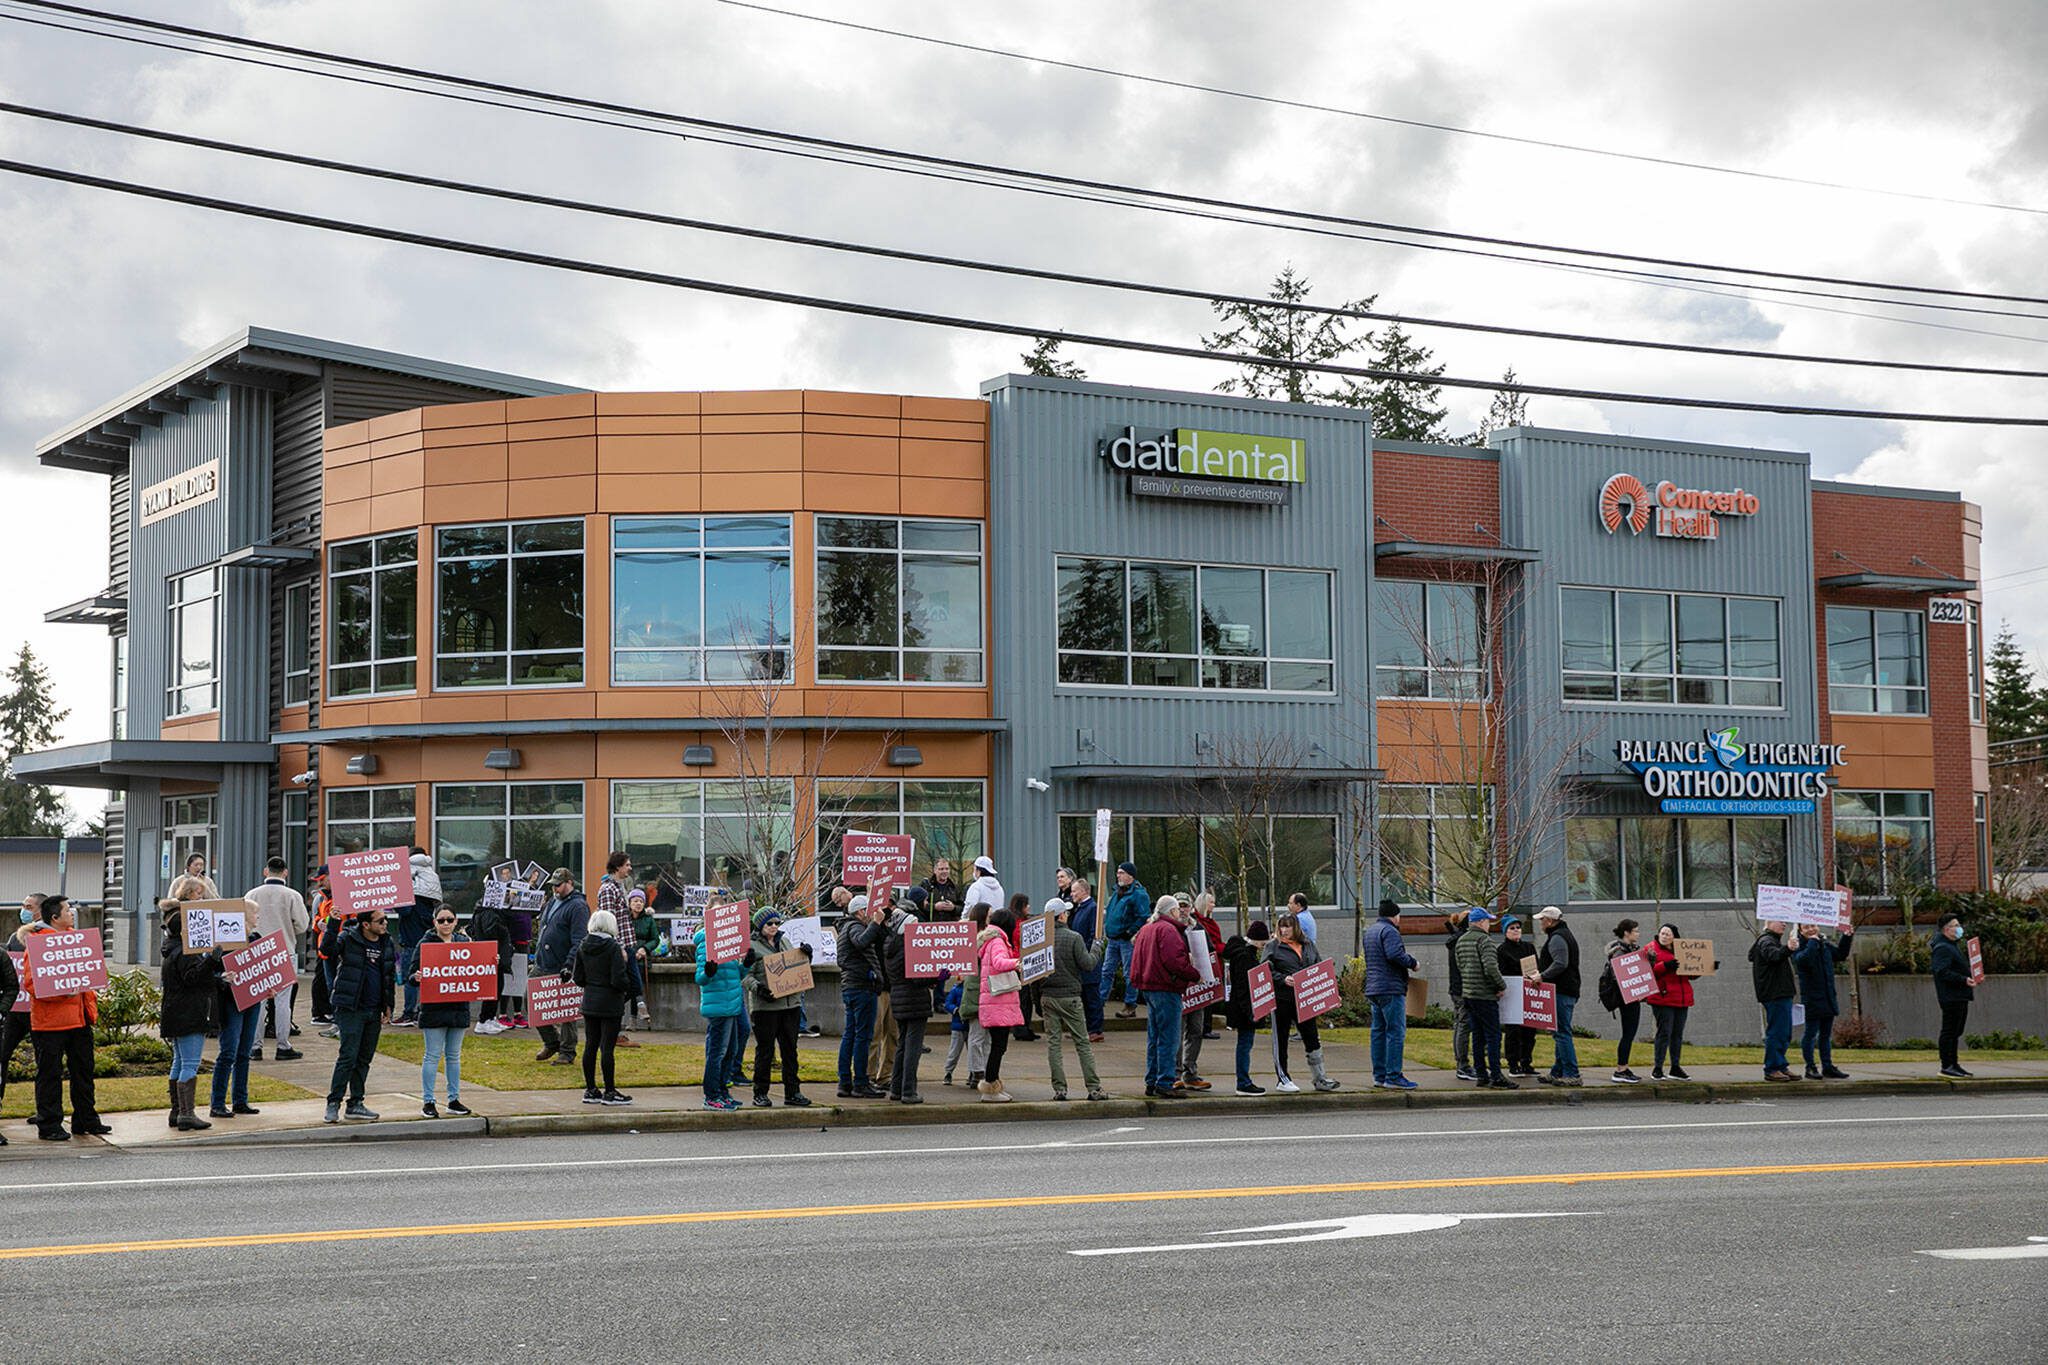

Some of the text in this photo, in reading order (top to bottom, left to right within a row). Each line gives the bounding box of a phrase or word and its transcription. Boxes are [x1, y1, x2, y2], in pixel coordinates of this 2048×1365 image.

[172, 470, 215, 505] BUILDING
[1139, 477, 1284, 504] family & preventive dentistry
[1656, 481, 1760, 515] Concerto
[1657, 507, 1719, 538] Health
[1932, 601, 1963, 621] 2322
[1619, 740, 1848, 766] BALANCE EPIGENETIC
[1644, 766, 1828, 798] ORTHODONTICS
[1720, 801, 1812, 812] ORTHOPEDICS-SLEEP
[866, 836, 887, 844] STOP
[343, 852, 395, 867] SAY NO TO
[340, 863, 401, 877] "PRETENDING
[352, 875, 392, 887] TO CARE
[349, 885, 398, 899] PROFITING
[352, 900, 370, 909] OFF
[371, 896, 398, 907] PAIN"
[189, 910, 205, 921] NO
[715, 904, 738, 918] DEPT OF
[713, 914, 741, 929] HEALTH IS
[717, 926, 739, 938] RUBBER
[916, 925, 968, 935] ACADIA IS
[46, 933, 85, 947] STOP
[713, 935, 743, 950] STAMPING
[912, 937, 972, 947] FOR PROFIT,
[42, 946, 93, 962] GREED
[234, 938, 277, 966] WE WERE
[450, 949, 471, 960] NO
[717, 946, 740, 959] PROJECT
[930, 950, 954, 959] NOT
[913, 963, 934, 972] FOR
[1620, 954, 1641, 967] ACADIA
[36, 960, 103, 977] PROTECT
[233, 950, 289, 986] CAUGHT OFF
[422, 964, 497, 978] BACKROOM
[1306, 966, 1319, 977] STOP
[54, 975, 91, 990] KIDS
[540, 977, 562, 988] WHY
[1257, 971, 1265, 982] WE
[1301, 971, 1328, 989] CORPORATE
[1621, 972, 1652, 989] REVOKE THE
[249, 972, 282, 996] GUARD
[440, 981, 480, 994] DEALS
[1253, 982, 1272, 999] DEMAND
[1298, 979, 1335, 999] GREED MASKED
[532, 989, 558, 1000] DRUG
[1299, 988, 1336, 1008] AS COMMUNITY
[1525, 986, 1551, 999] YOU ARE
[534, 1000, 559, 1010] HAVE
[1312, 1001, 1326, 1012] CARE
[1530, 1000, 1544, 1009] NOT
[542, 1007, 580, 1020] RIGHTS?
[1523, 1011, 1553, 1023] DOCTORS!
